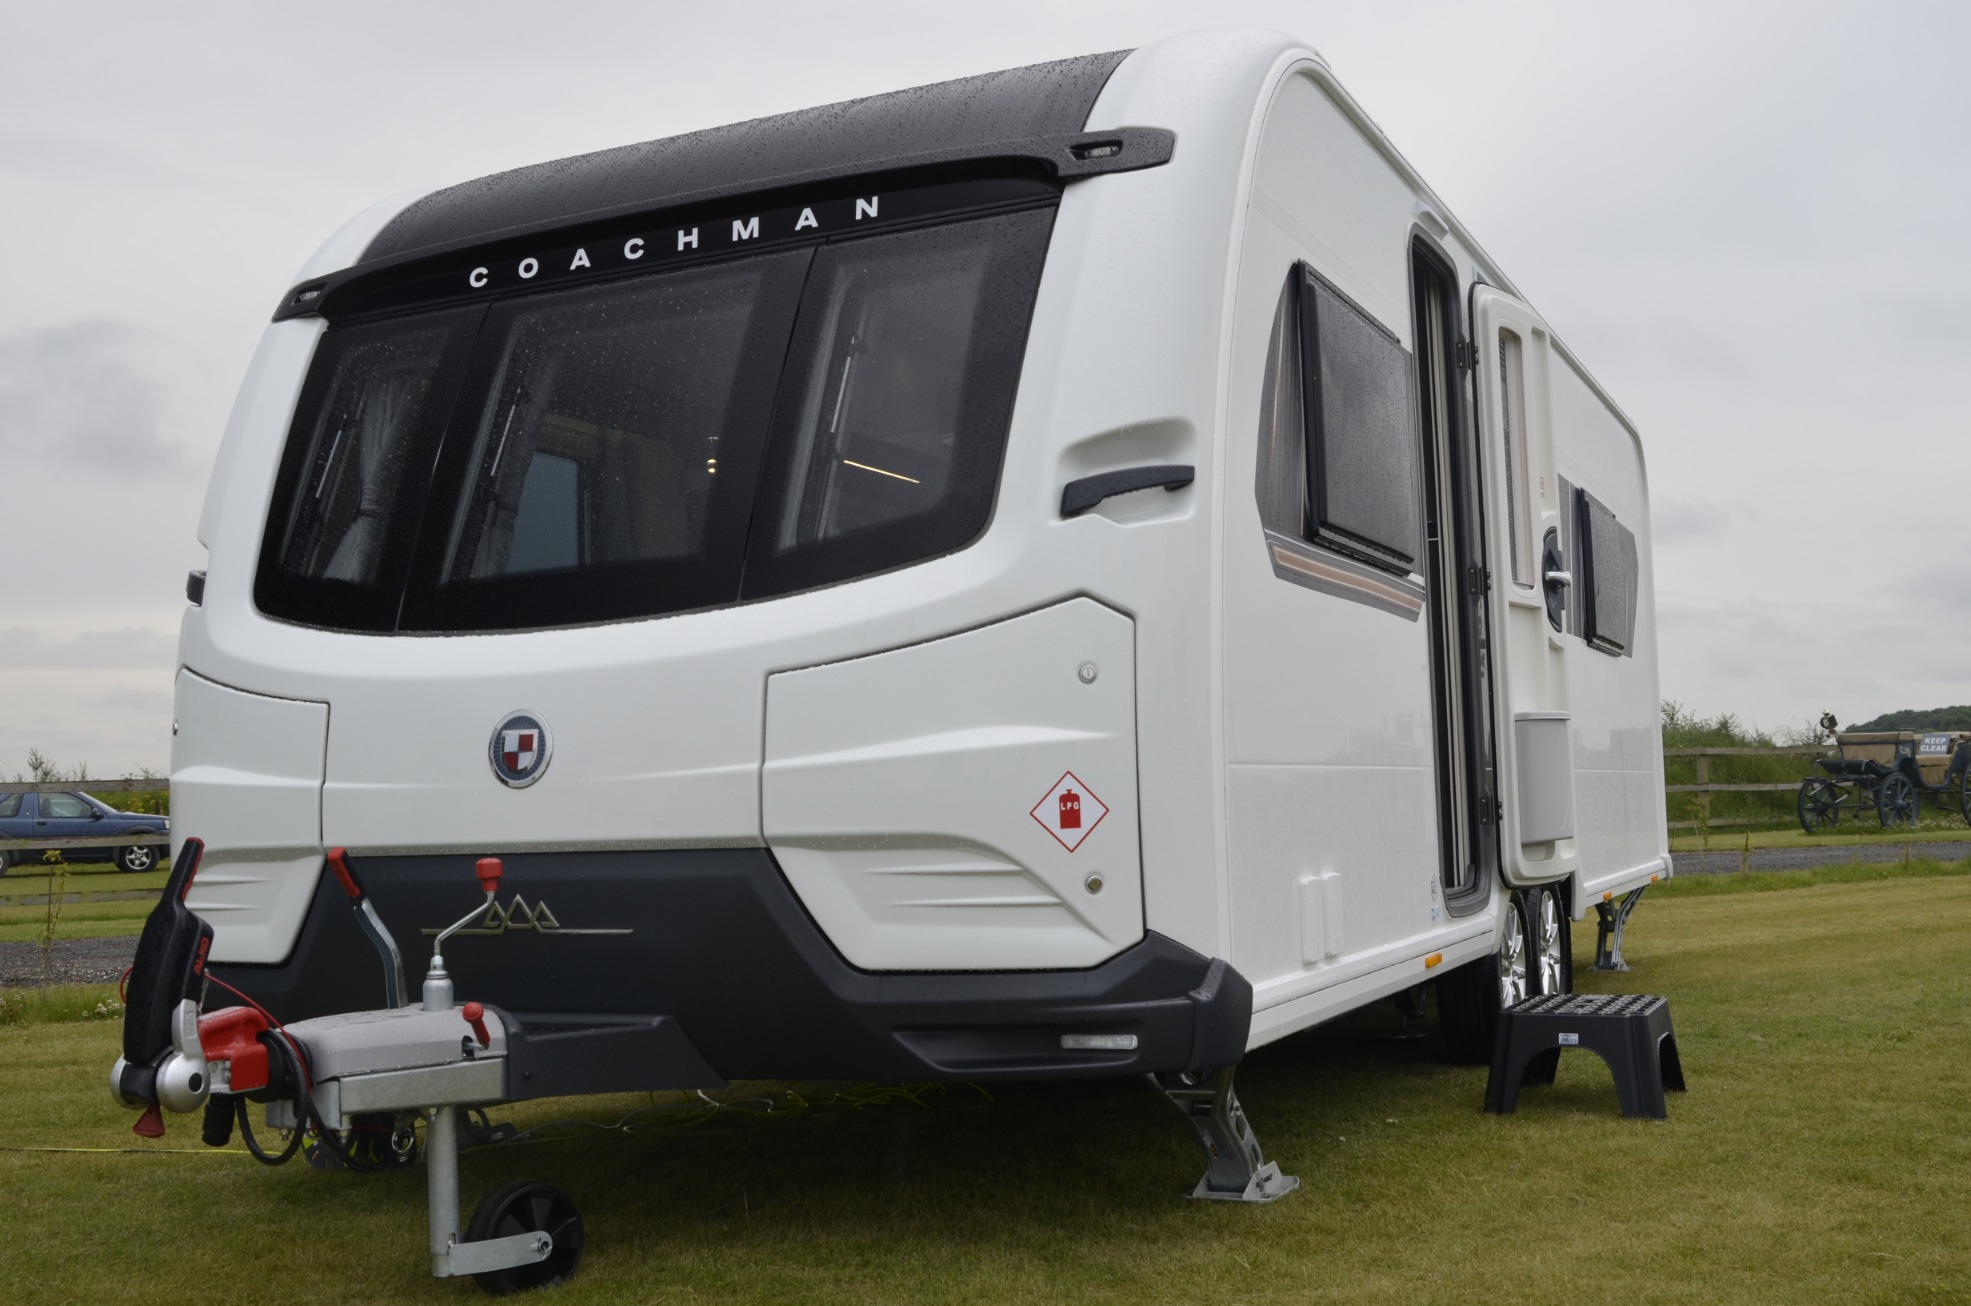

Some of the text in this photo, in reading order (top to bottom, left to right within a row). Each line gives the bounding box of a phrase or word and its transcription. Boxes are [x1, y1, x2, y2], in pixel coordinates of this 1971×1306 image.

[469, 196, 879, 288] COACHMAN
[1924, 737, 1947, 745] KEEP
[1060, 801, 1080, 811] LPG
